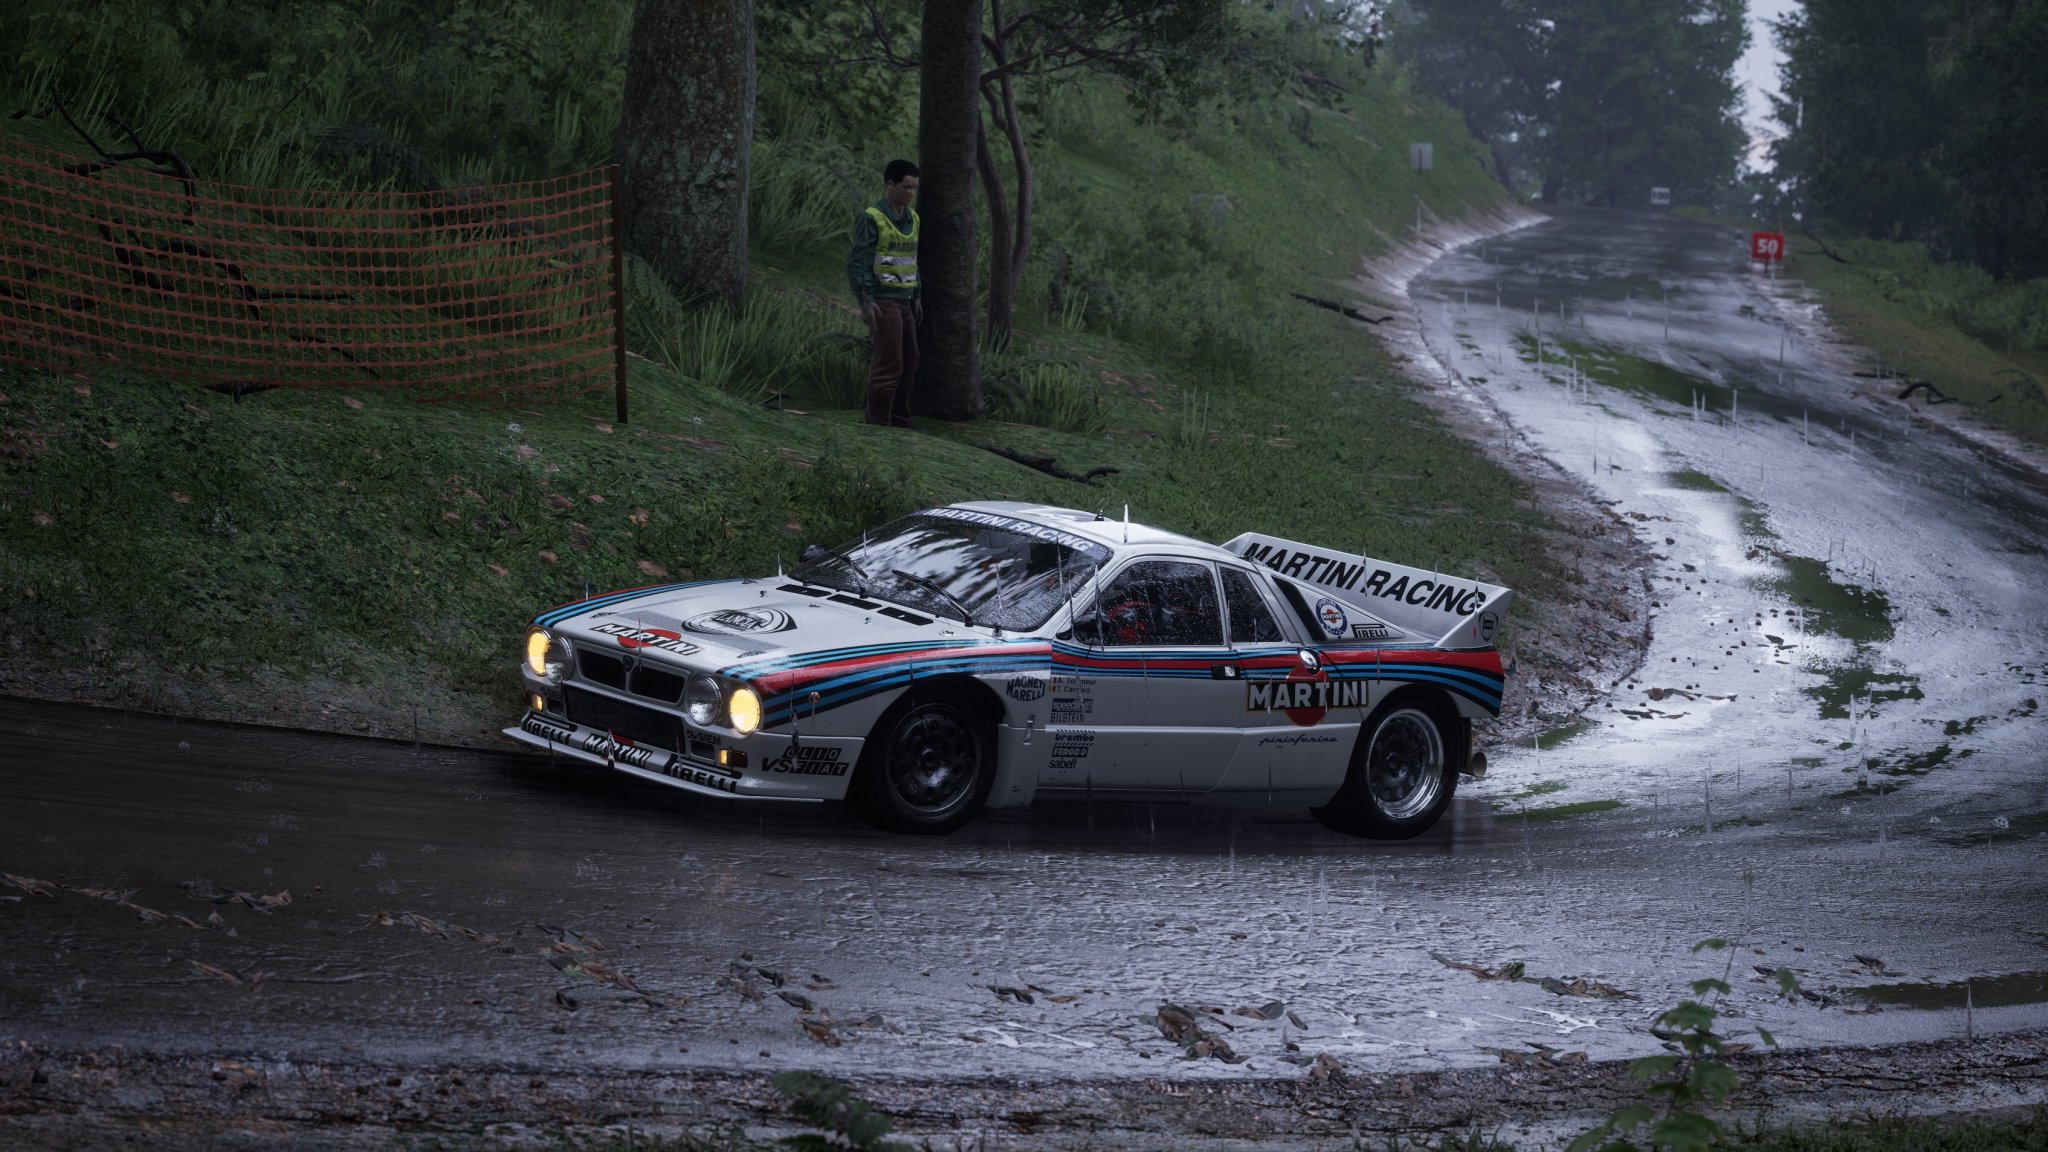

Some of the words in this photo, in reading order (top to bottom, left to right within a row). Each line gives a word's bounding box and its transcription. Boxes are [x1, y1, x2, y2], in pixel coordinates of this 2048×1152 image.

[1652, 190, 1669, 201] 100
[1757, 238, 1779, 254] 50
[922, 507, 1015, 527] MARTINI
[1008, 520, 1095, 552] RACING
[1243, 542, 1365, 590] MARTINI
[1361, 569, 1487, 616] RACING
[1351, 623, 1389, 638] PIRELLI
[595, 623, 701, 656] MARTINI
[1007, 676, 1045, 690] MAGNETI
[1006, 687, 1045, 702] MARELLI
[1248, 680, 1367, 709] MARTINI
[1050, 712, 1085, 723] BILSTEIN
[521, 711, 577, 745] PIRELLI
[1055, 733, 1095, 742] brembo
[1053, 747, 1087, 757] FERODO
[761, 758, 791, 773] VS
[1049, 758, 1078, 769] sabelt
[664, 753, 742, 793] PIRELLI
